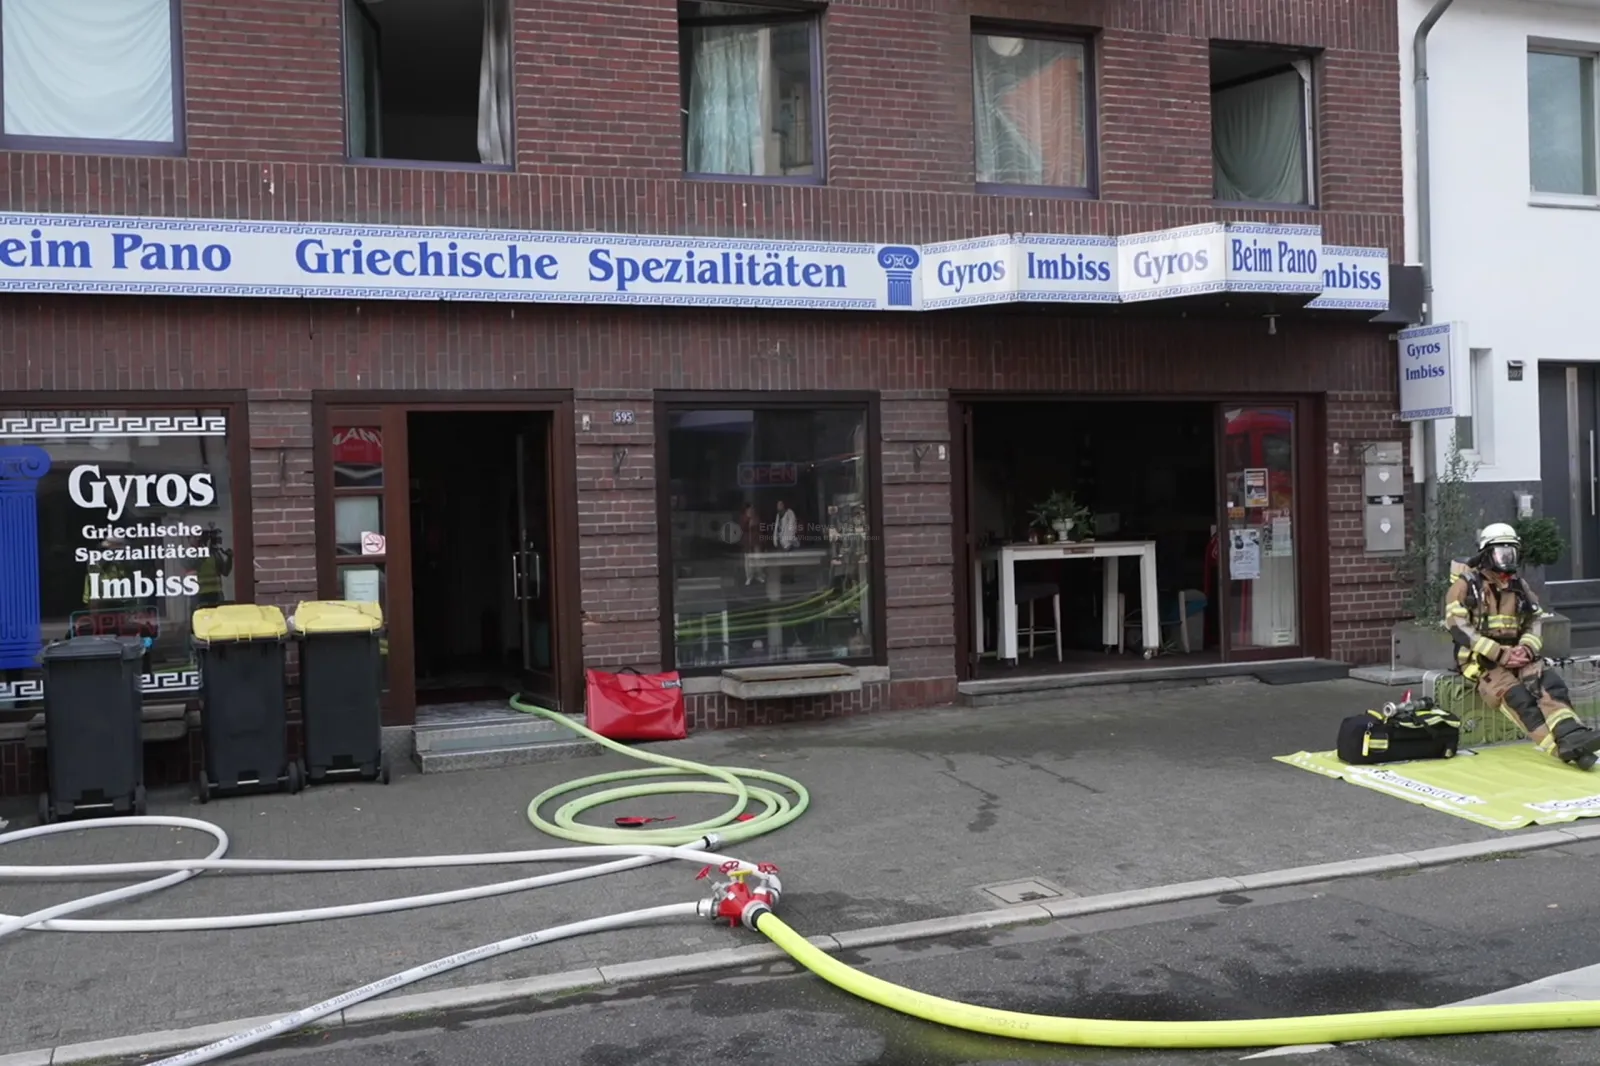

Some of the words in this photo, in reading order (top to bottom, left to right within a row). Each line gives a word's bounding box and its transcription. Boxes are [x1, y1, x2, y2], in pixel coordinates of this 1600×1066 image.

[111, 233, 232, 271] Pano
[295, 239, 559, 280] Griechische
[588, 249, 847, 291] Spezialitäten
[1027, 252, 1111, 282] Imbiss
[1133, 248, 1209, 284] Gyros
[1231, 239, 1273, 273] Beim
[1278, 240, 1318, 275] Pano
[937, 259, 1006, 293] Gyros
[1322, 262, 1382, 290] mbiss
[1406, 341, 1441, 358] Gyros
[1405, 364, 1445, 381] Imbiss
[615, 412, 633, 422] 595
[741, 467, 795, 483] OPEN
[68, 464, 215, 521] Gyros
[82, 522, 203, 540] Griechische
[75, 545, 210, 565] Spezialitäten
[88, 569, 200, 600] Imbiss
